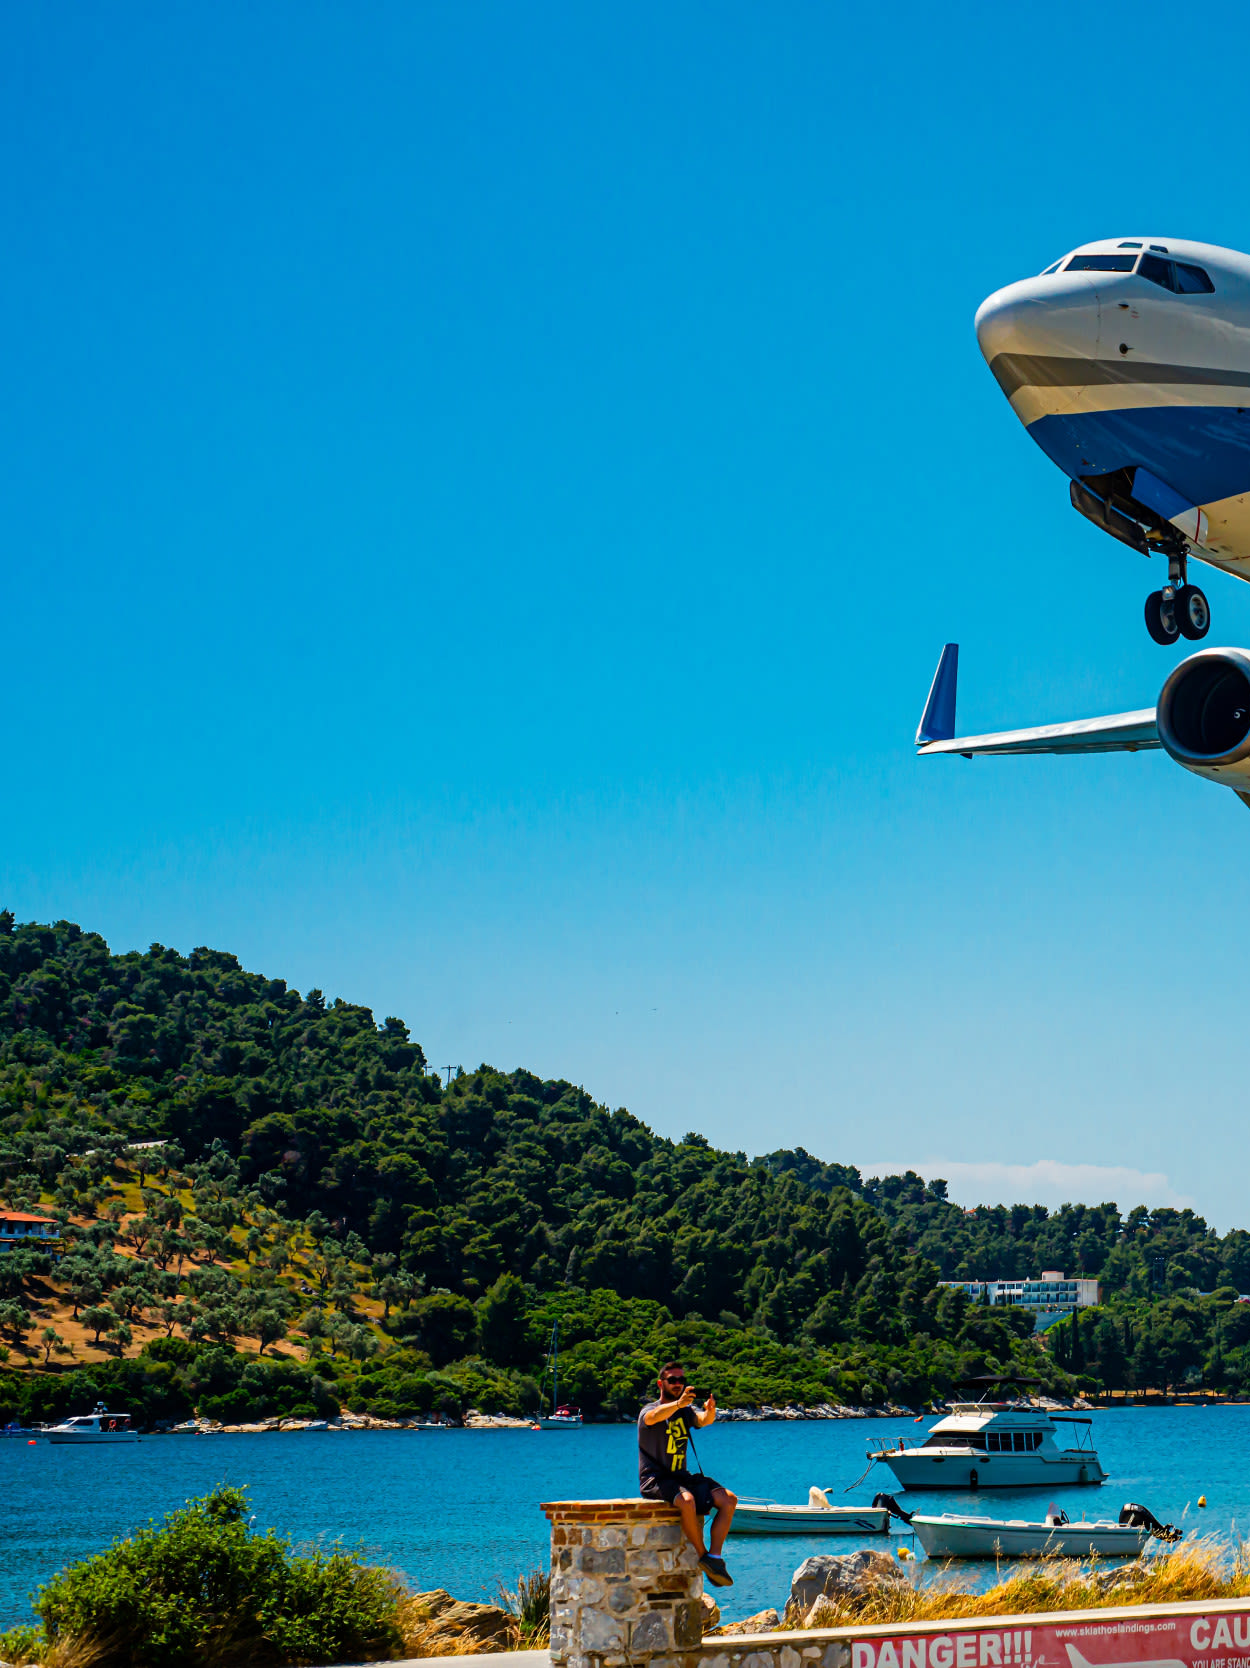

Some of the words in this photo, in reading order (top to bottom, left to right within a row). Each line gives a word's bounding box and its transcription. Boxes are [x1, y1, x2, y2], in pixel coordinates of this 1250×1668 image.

[666, 1417, 687, 1438] JST
[671, 1454, 685, 1472] IT
[1055, 1621, 1176, 1638] www.skiathoslandings.com
[852, 1630, 1032, 1668] DANGER!!!
[1210, 1658, 1226, 1668] ARE
